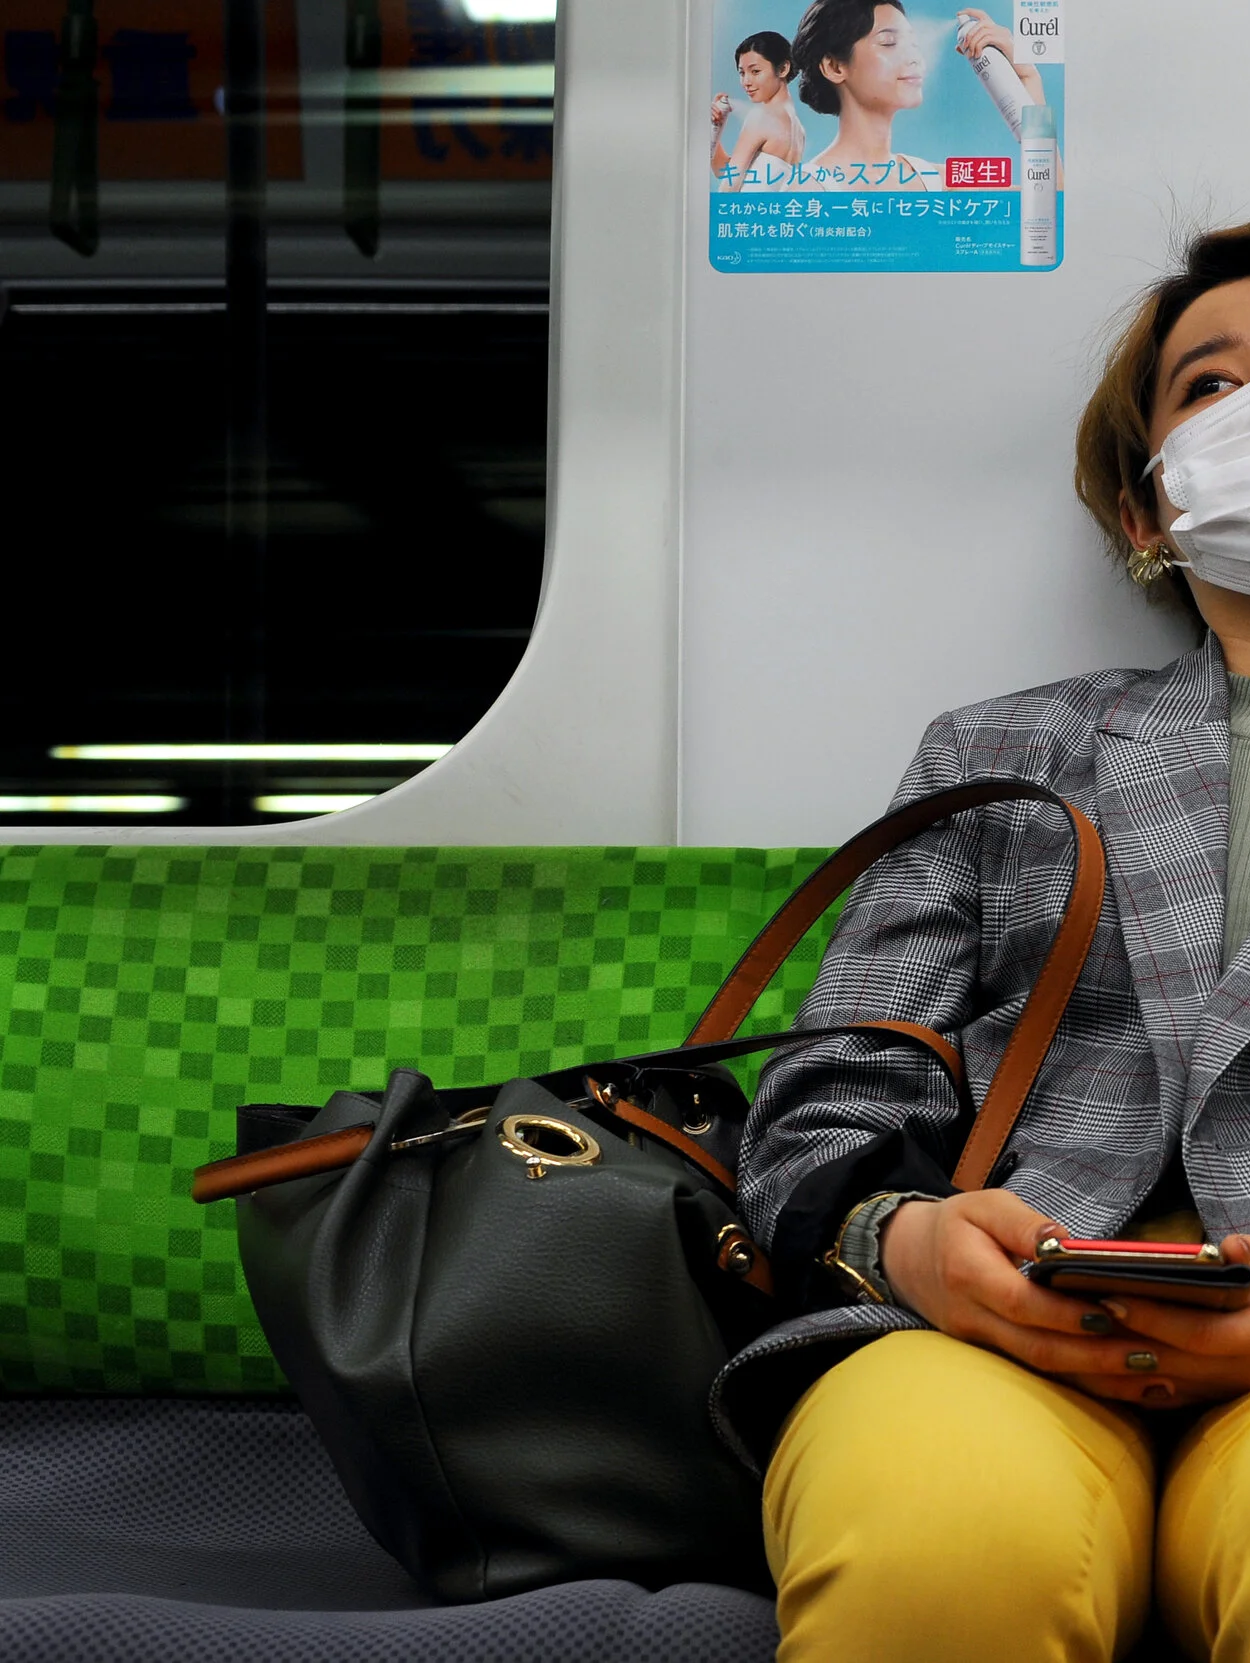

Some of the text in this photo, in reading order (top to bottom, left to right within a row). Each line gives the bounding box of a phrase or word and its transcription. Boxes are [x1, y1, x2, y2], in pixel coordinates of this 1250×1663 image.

[1019, 17, 1060, 36] Curél
[718, 160, 1006, 186] キュレルからスプレー 誕生!
[1027, 168, 1050, 181] Curél
